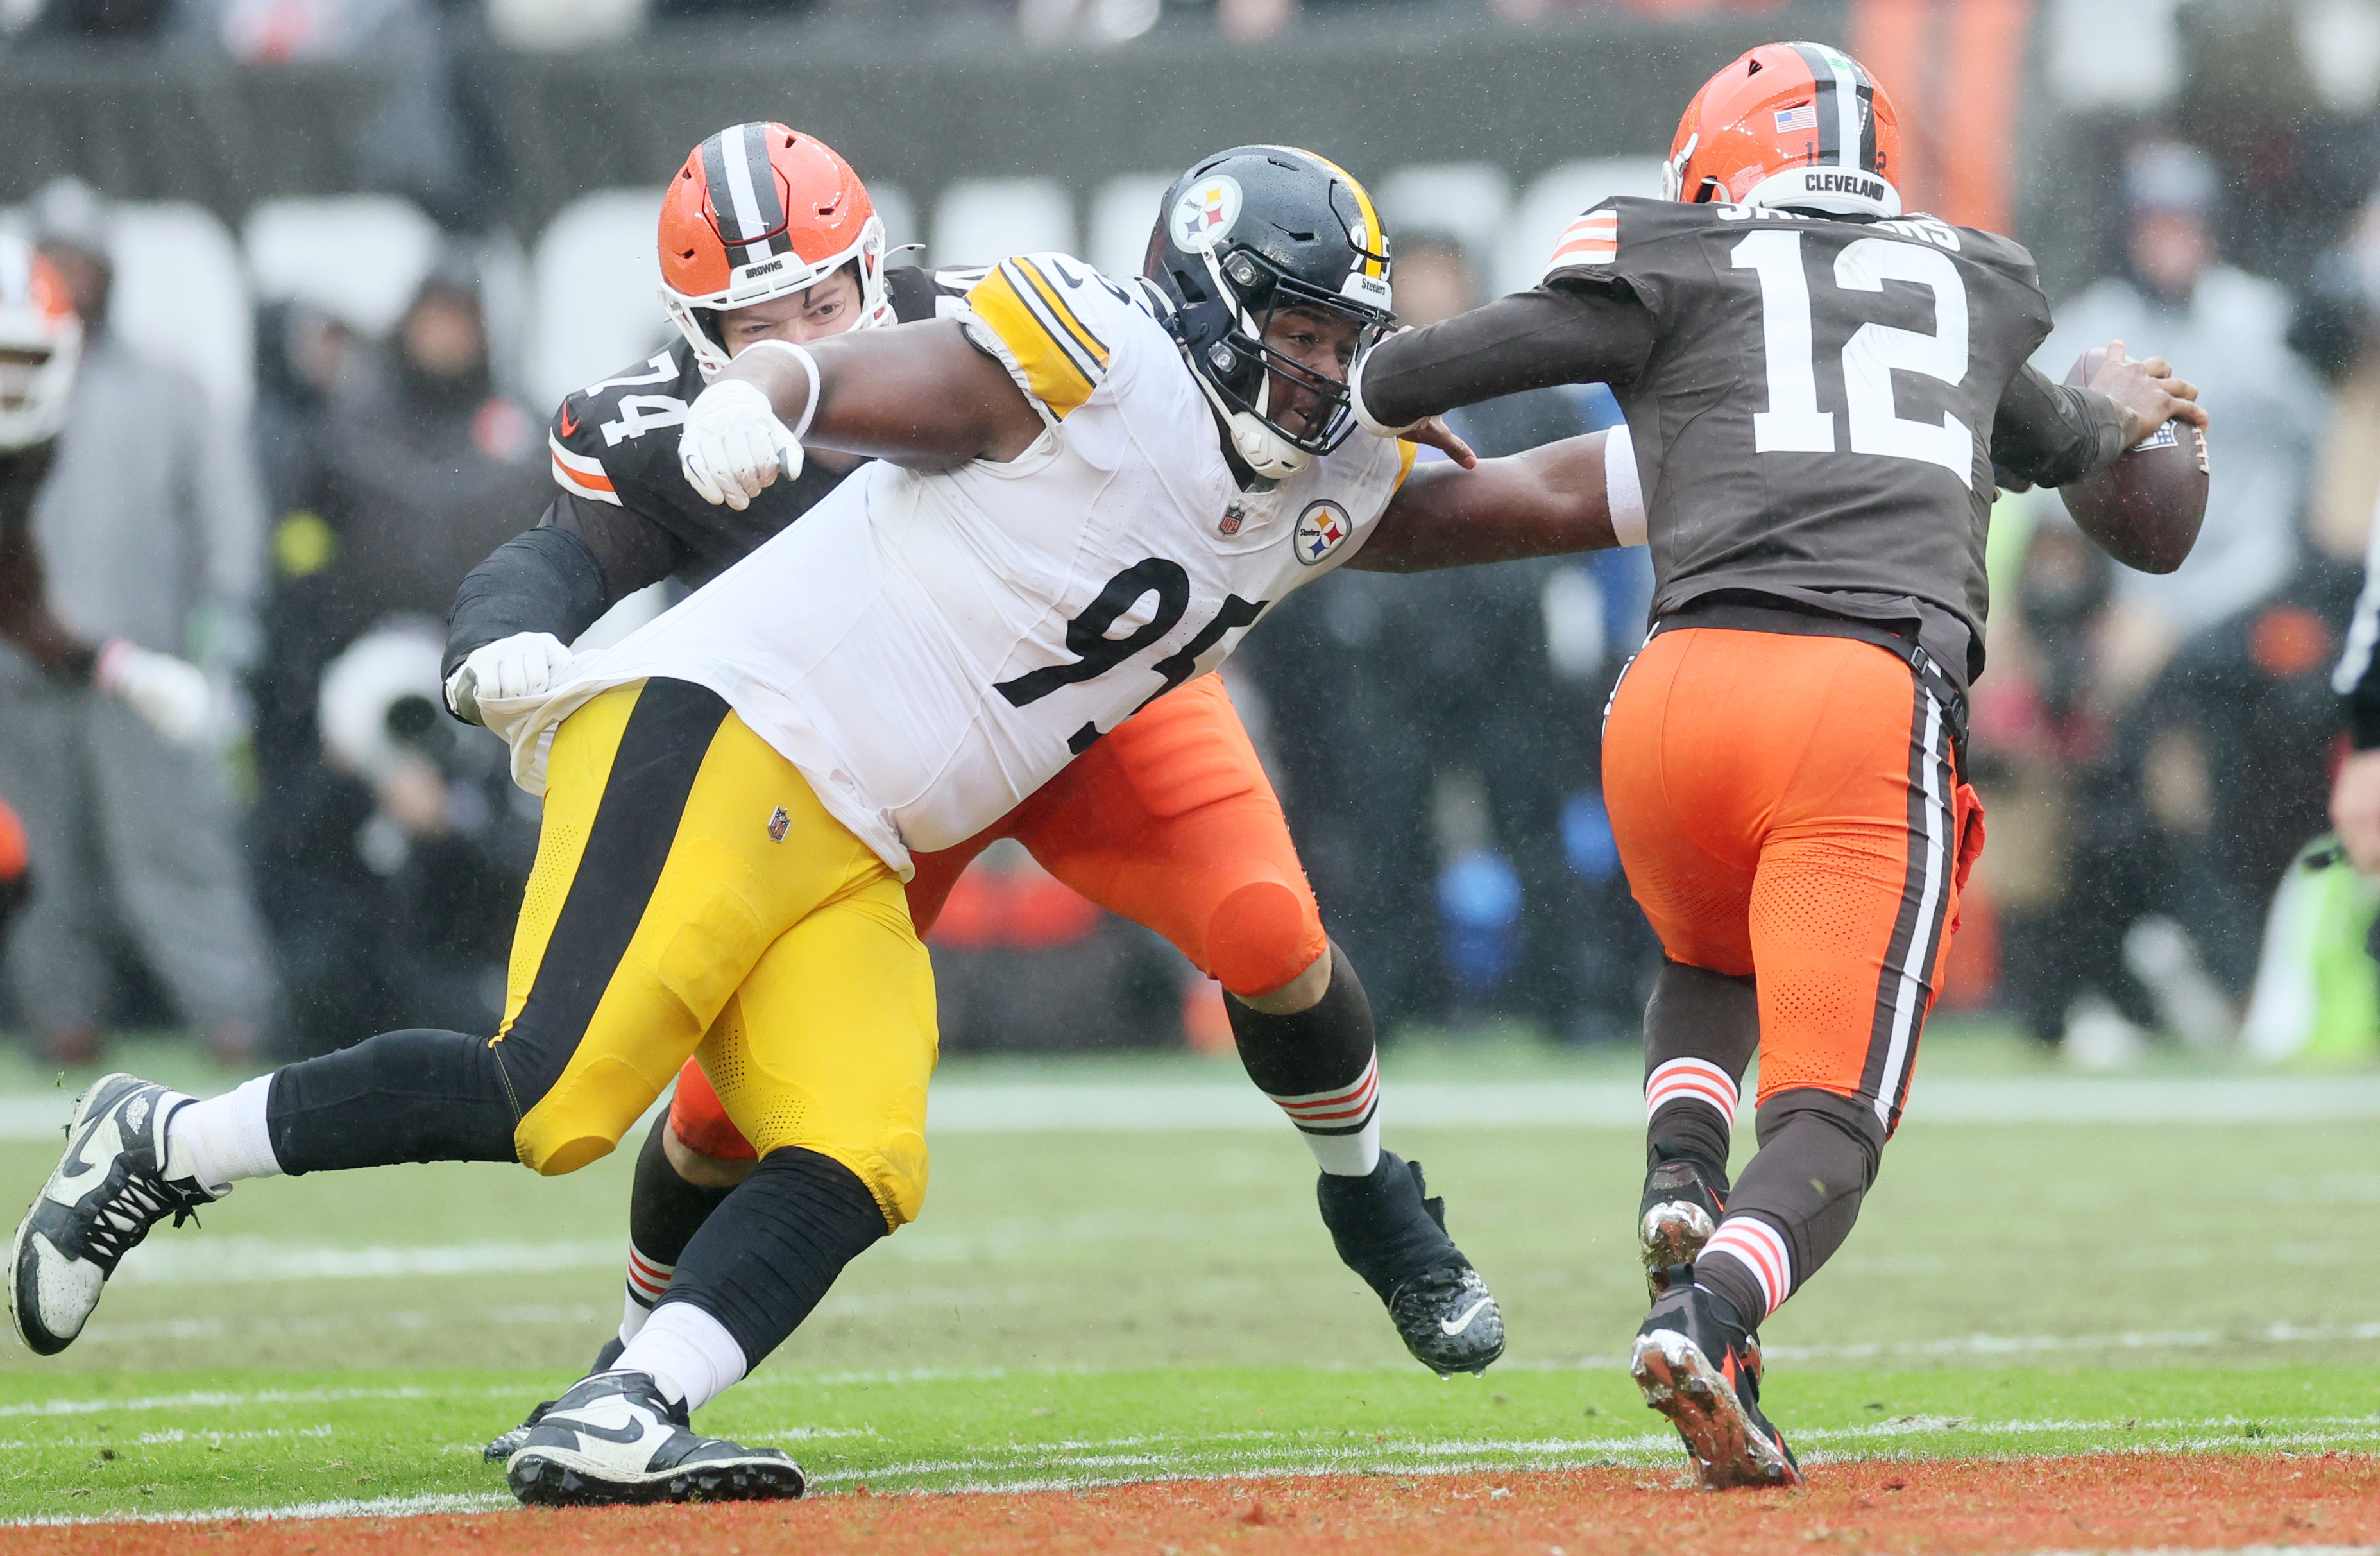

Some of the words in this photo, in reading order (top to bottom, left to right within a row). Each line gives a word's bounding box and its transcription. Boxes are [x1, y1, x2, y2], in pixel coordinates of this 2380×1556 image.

[1805, 174, 1885, 201] CLEVELAND
[1349, 225, 1391, 282] 95
[745, 260, 783, 278] BROWNS
[1362, 278, 1385, 295] Steelers
[1731, 230, 1973, 491] 12
[584, 349, 690, 447] 74
[1221, 517, 1240, 533] NFL
[1300, 528, 1320, 536] Steelers
